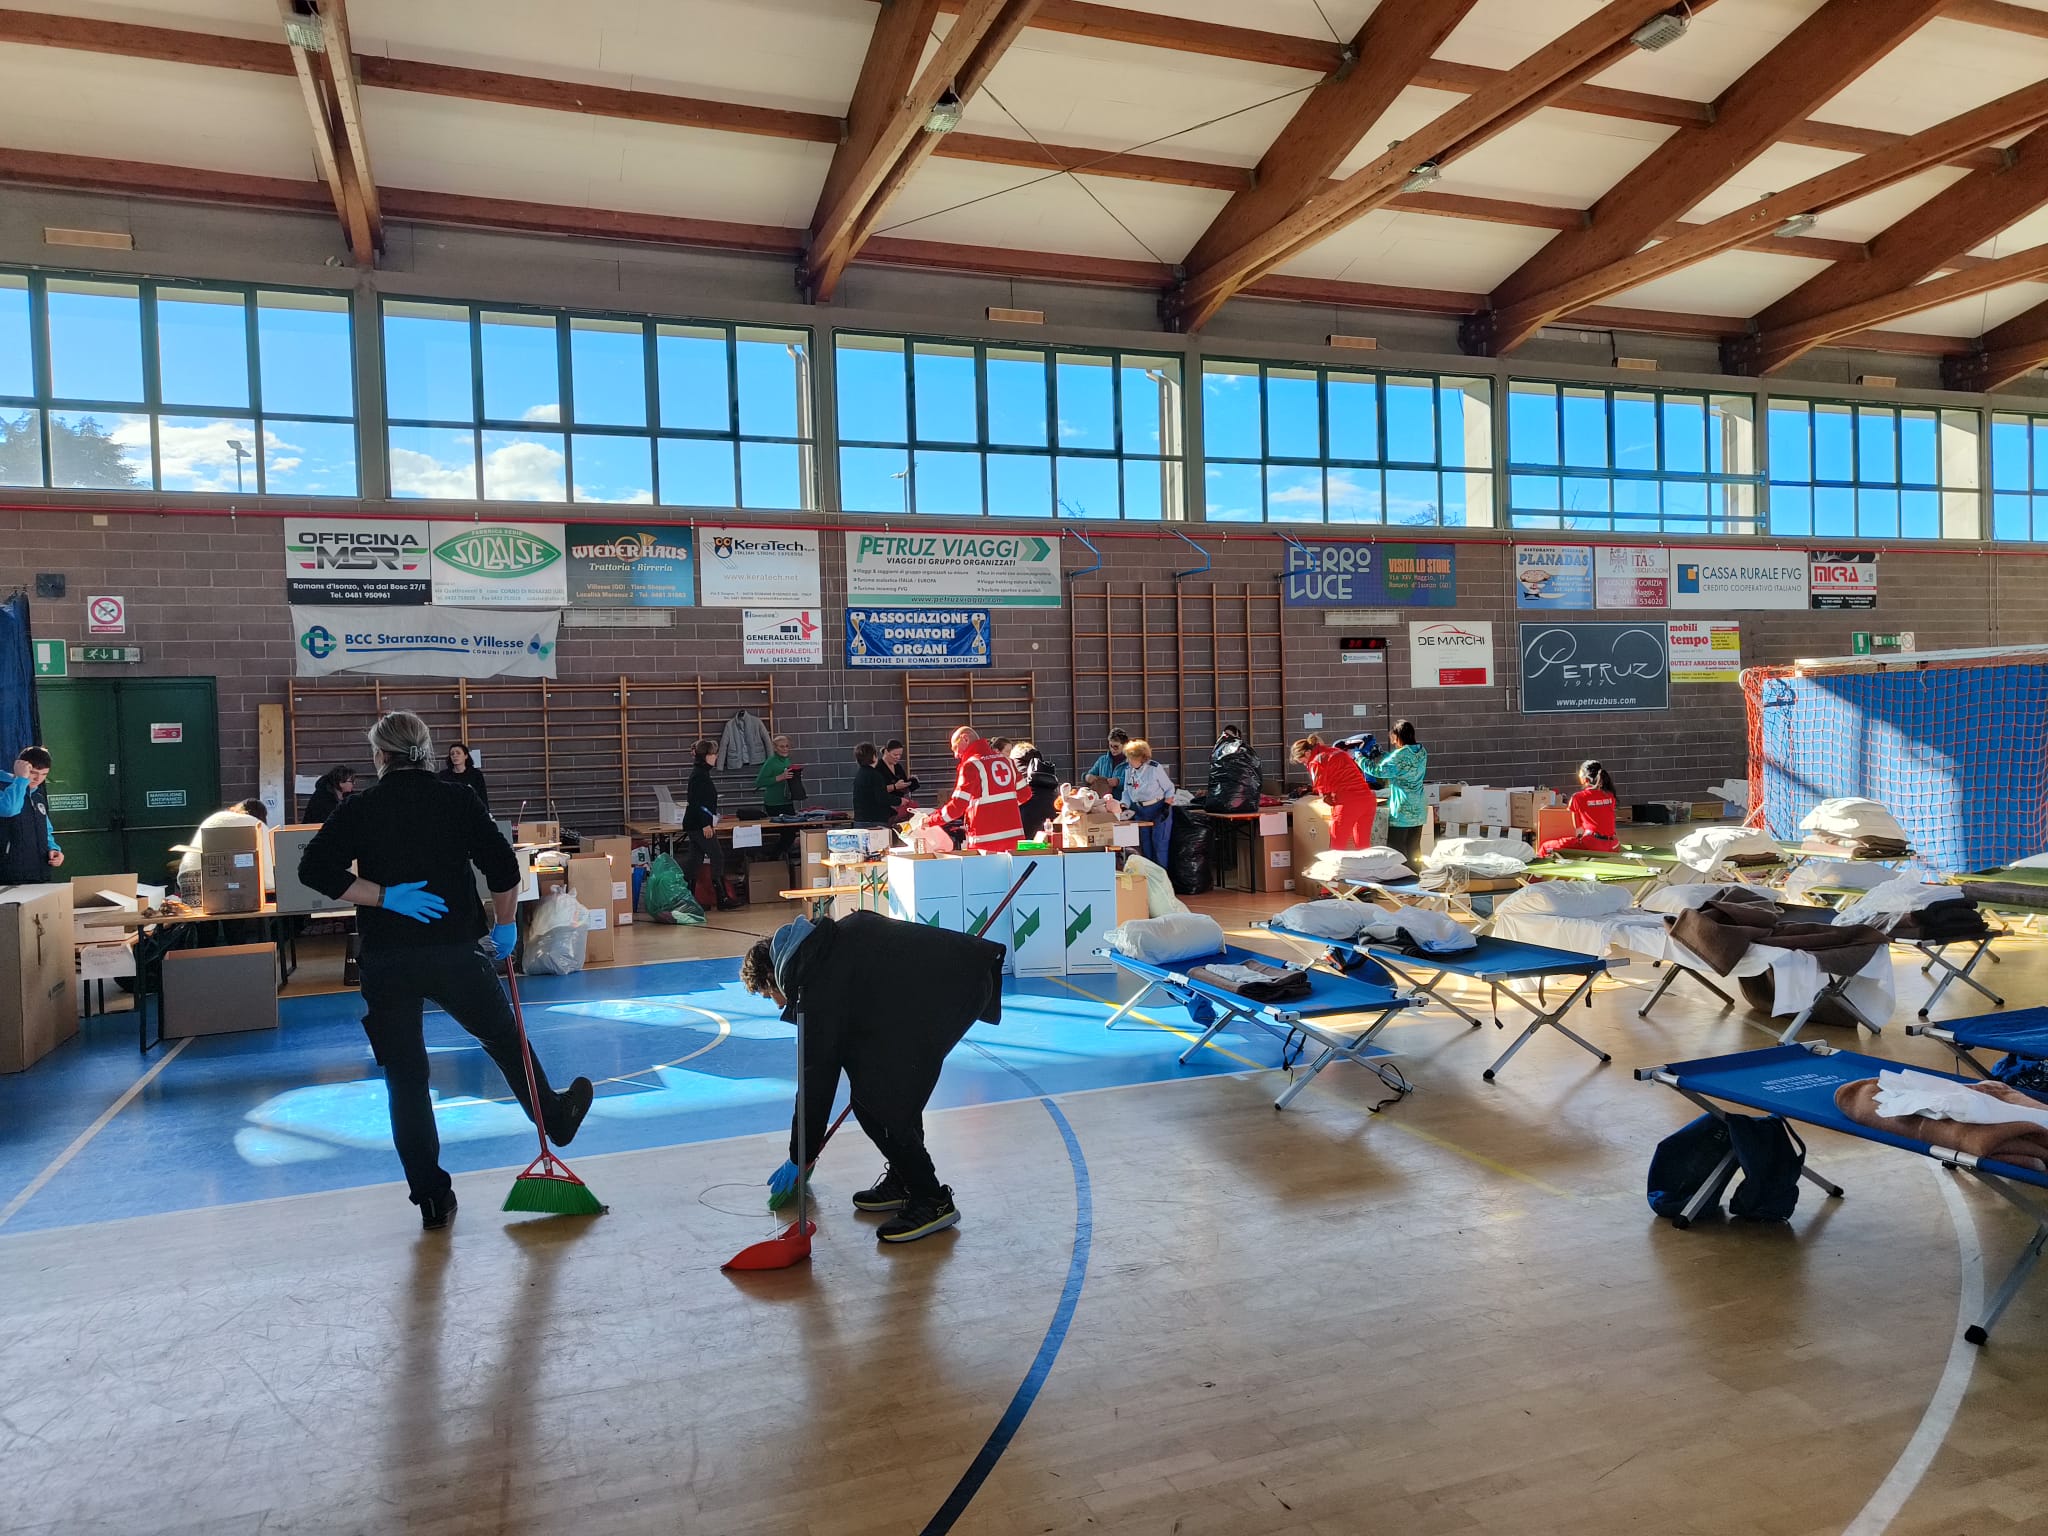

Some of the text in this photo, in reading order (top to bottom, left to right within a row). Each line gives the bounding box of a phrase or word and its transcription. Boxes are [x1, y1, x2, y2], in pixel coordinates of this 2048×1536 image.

[298, 532, 419, 546] OFFICINA
[734, 539, 803, 552] KeraTech
[571, 545, 687, 561] WIENER HAUS
[858, 536, 1019, 558] PETRUZ VIAGGI
[317, 547, 400, 570] MSR
[886, 557, 916, 565] VIAGGI
[1289, 546, 1371, 573] FERRO
[1518, 553, 1589, 566] PLANADAS
[1631, 555, 1655, 567] ITAS
[589, 562, 672, 572] Trattoria Birreria
[1388, 558, 1451, 574] VISITA LO STORE
[1702, 567, 1801, 580] CASSA RURALE FVG
[1814, 565, 1859, 583] MICRA
[326, 583, 360, 591] d'Isonzo,
[1290, 574, 1353, 600] LUCE
[1638, 579, 1663, 587] GORIZIA
[1703, 584, 1728, 592] CREDITO
[1730, 584, 1772, 592] COOPERATIVO
[869, 612, 969, 624] ASSOCIAZIONE
[884, 628, 955, 639] DONATORI
[1670, 623, 1698, 632] mobili
[345, 633, 524, 648] BCC Staranzano e Villesse
[1417, 636, 1485, 646] DE MARCHI
[1670, 635, 1709, 648] tempo
[892, 644, 948, 655] ORGANI
[1556, 696, 1637, 707] www.petruzbus.com
